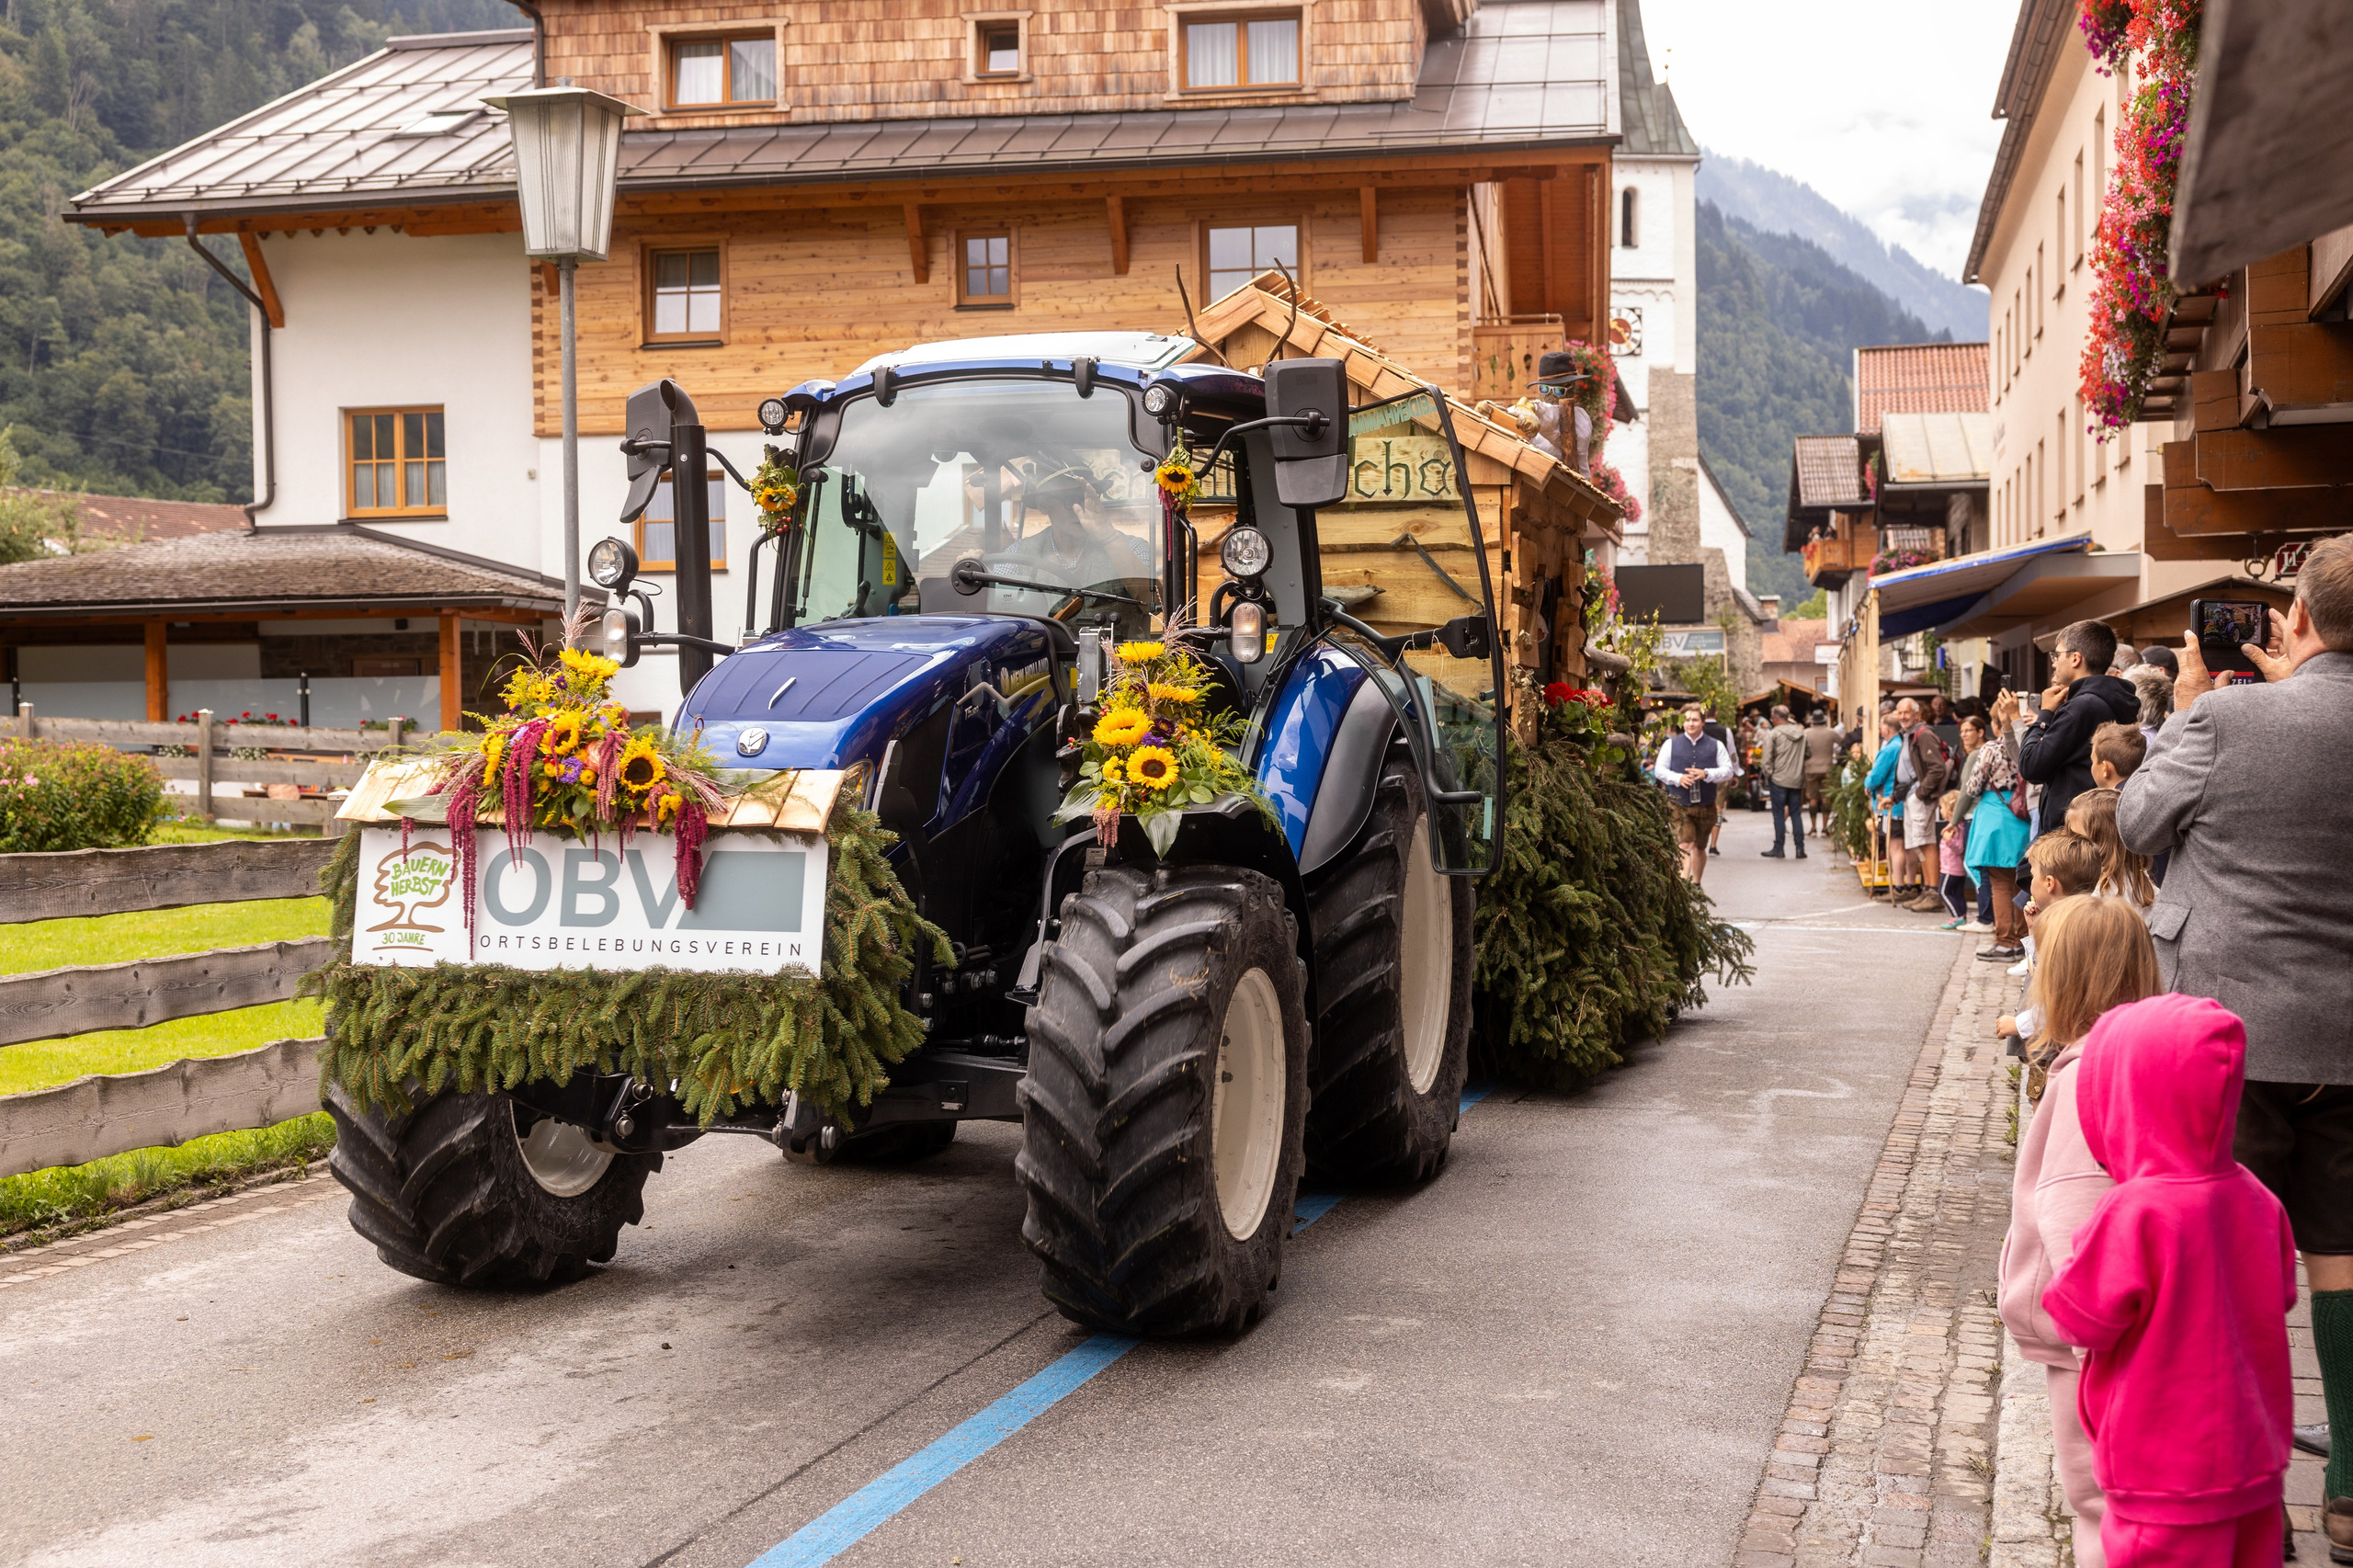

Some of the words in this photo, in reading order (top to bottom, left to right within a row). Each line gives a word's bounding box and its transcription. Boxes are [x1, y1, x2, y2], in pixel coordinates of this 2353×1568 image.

[1011, 667, 1024, 690] NEW
[1024, 656, 1049, 681] HOLLAND
[392, 856, 450, 880] BAUERN
[391, 876, 442, 897] HERBST
[483, 846, 691, 929] OBV
[381, 932, 394, 944] 30
[397, 932, 426, 945] JAHRE
[480, 935, 801, 956] ORTSBELEBUNGSVEREIN
